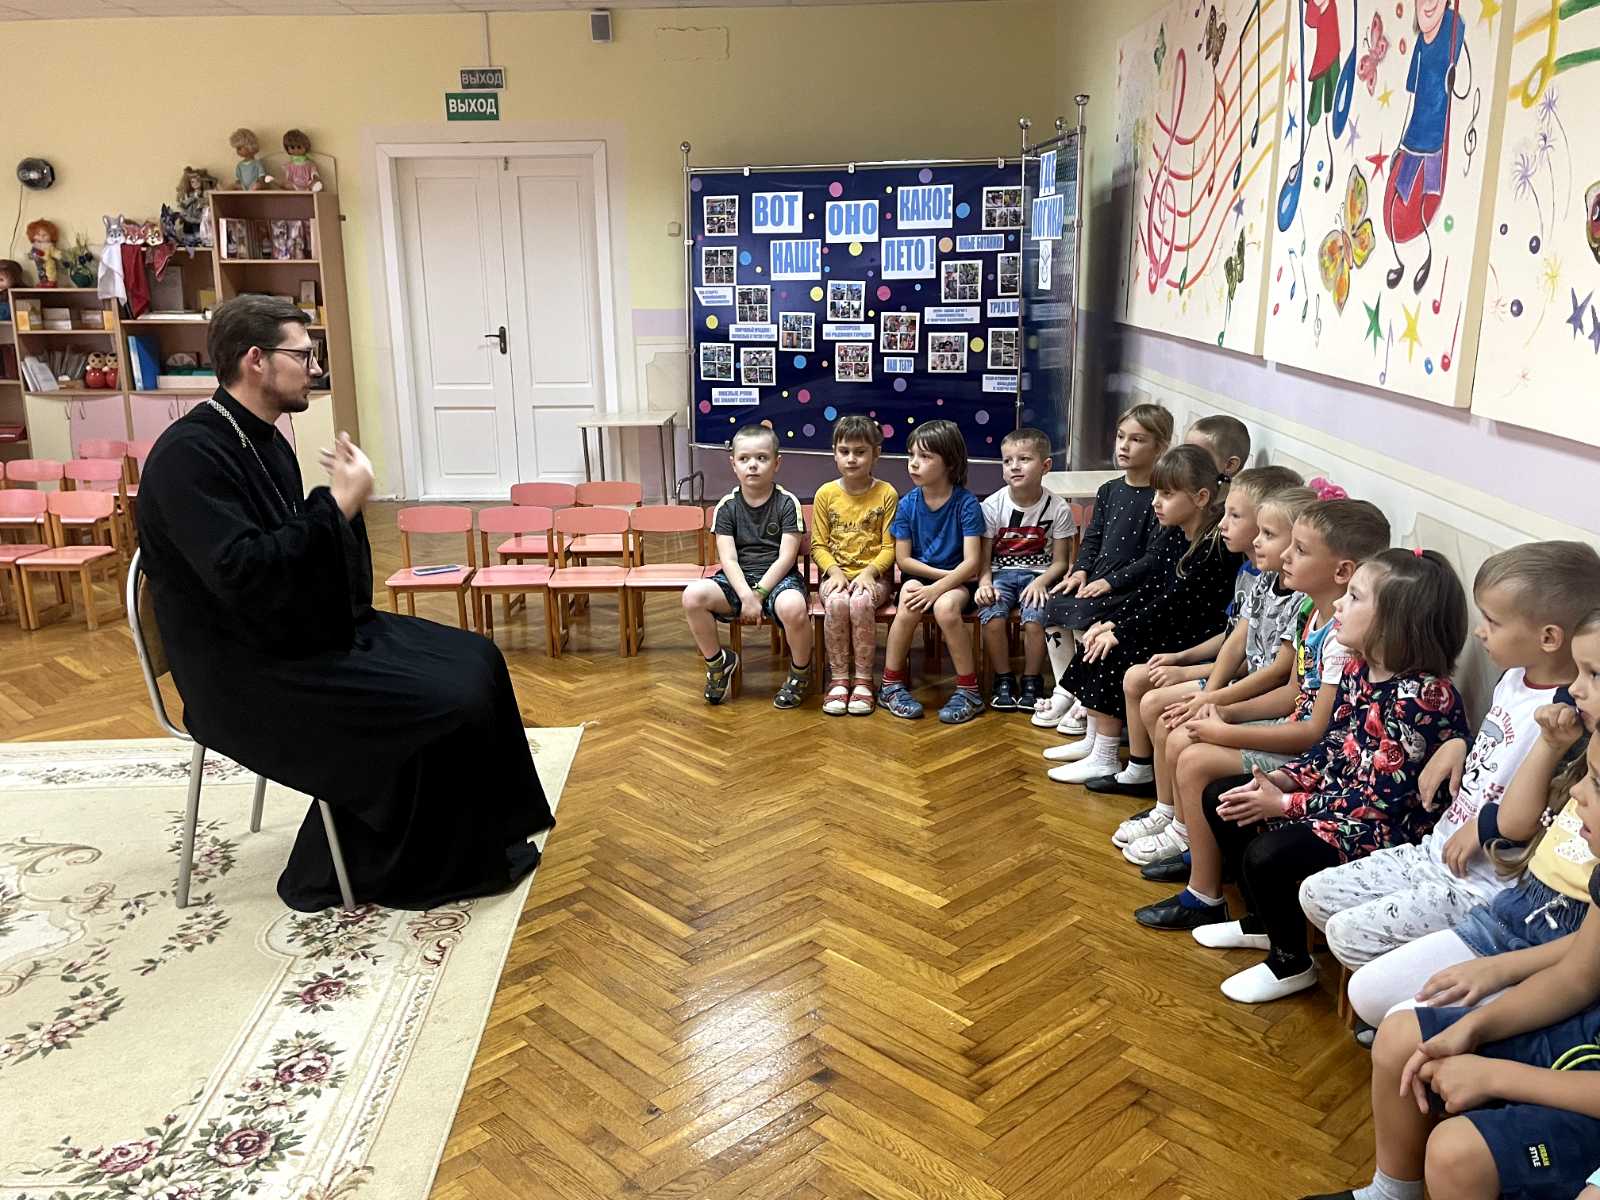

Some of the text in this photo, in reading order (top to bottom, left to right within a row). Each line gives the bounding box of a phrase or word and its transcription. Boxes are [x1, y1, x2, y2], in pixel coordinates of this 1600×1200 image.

[462, 73, 502, 85] ВЫХОД
[448, 98, 497, 115] ВЫХОД
[754, 187, 952, 236] ВОТ ОНО КАКОЕ
[772, 240, 820, 274] НАШЕ
[899, 359, 913, 372] ТЕАТР
[1529, 1146, 1541, 1168] STYLE
[1538, 1144, 1551, 1166] URBAN
